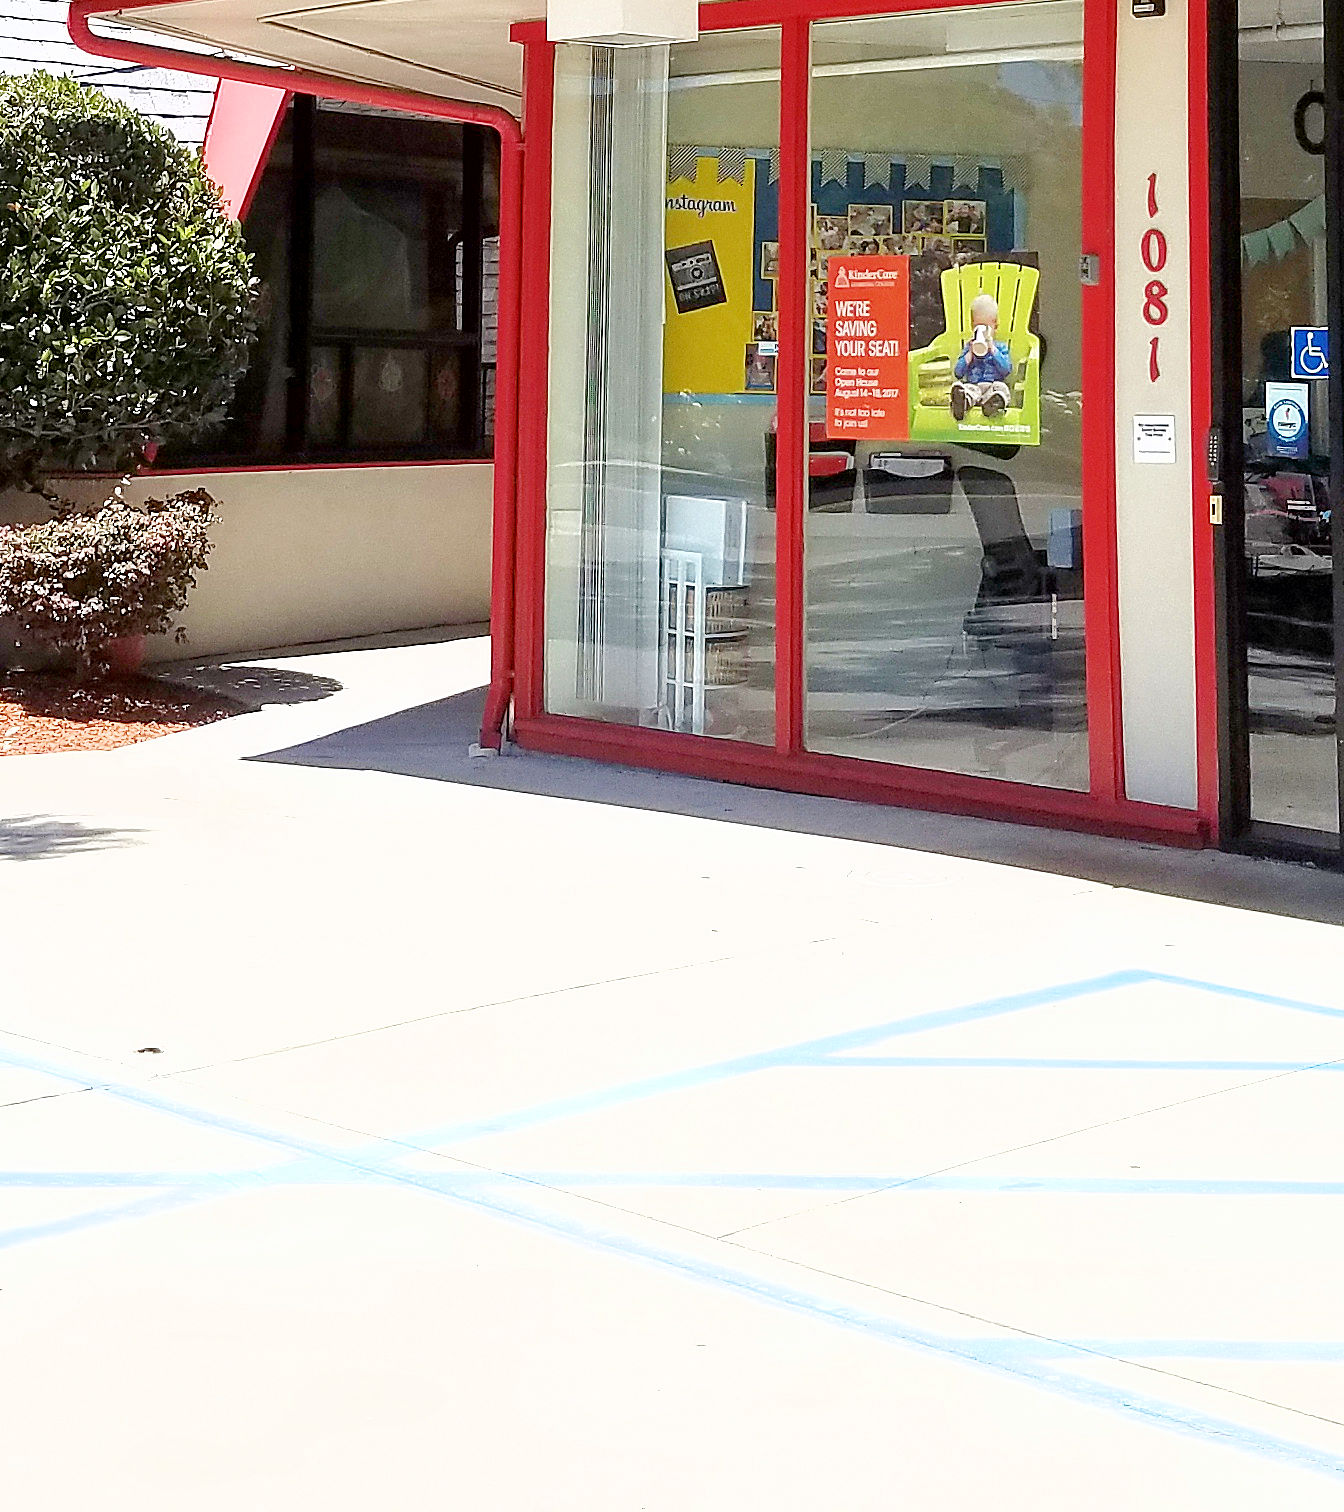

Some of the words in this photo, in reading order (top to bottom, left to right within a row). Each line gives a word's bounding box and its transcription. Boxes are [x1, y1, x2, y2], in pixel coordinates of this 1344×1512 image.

[665, 194, 736, 218] nstagram
[848, 268, 898, 279] KinderCare
[1141, 172, 1168, 383] 1081
[835, 300, 871, 317] WE'RE
[835, 320, 877, 337] SAVING
[835, 340, 866, 357] YOUR
[868, 340, 899, 357] SEAT!
[835, 367, 857, 376] Come
[857, 367, 866, 376] to
[835, 378, 855, 387] Open
[856, 378, 879, 386] House
[835, 388, 859, 399] August
[882, 388, 899, 398] 2017
[857, 408, 870, 417] too
[834, 418, 842, 427] to
